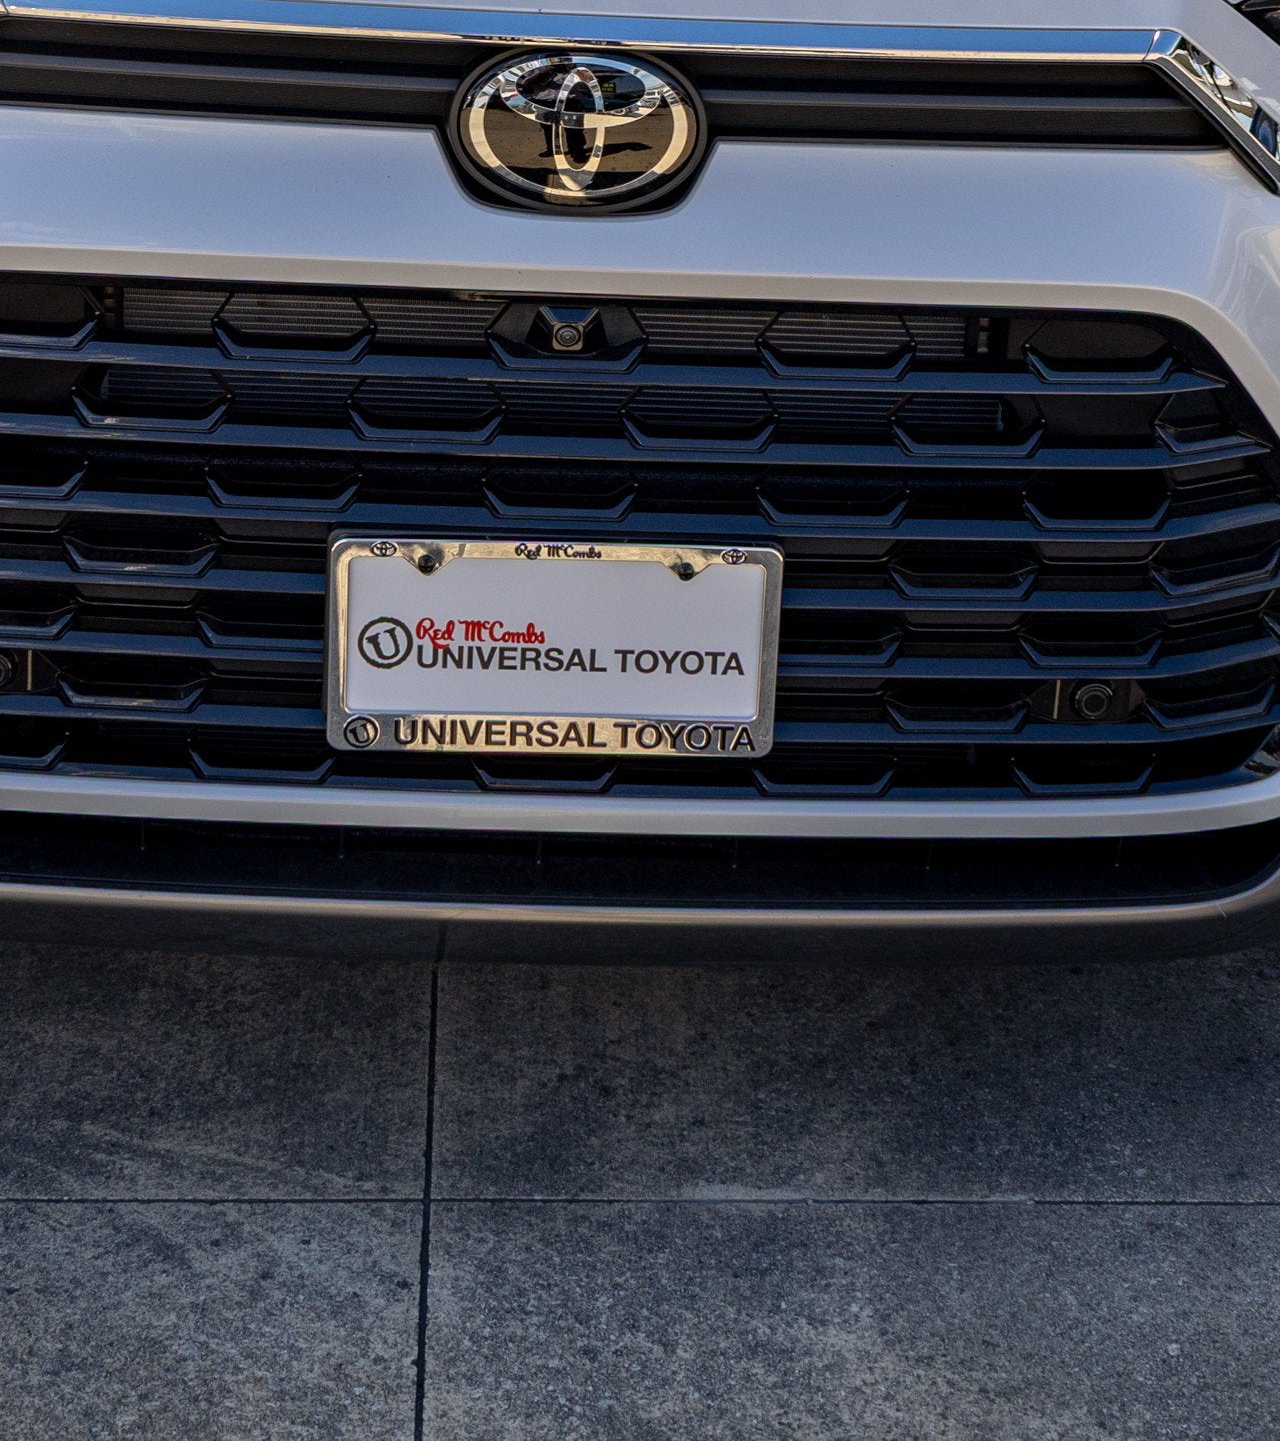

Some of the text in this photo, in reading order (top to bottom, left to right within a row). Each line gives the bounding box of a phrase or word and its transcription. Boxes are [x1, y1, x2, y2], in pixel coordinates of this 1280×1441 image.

[515, 542, 602, 560] Red McCombs
[415, 617, 545, 650] Red McCombs
[416, 644, 745, 676] UNIVERSAL TOYOTA
[394, 717, 756, 752] UNIVERSAL TOYOTA
